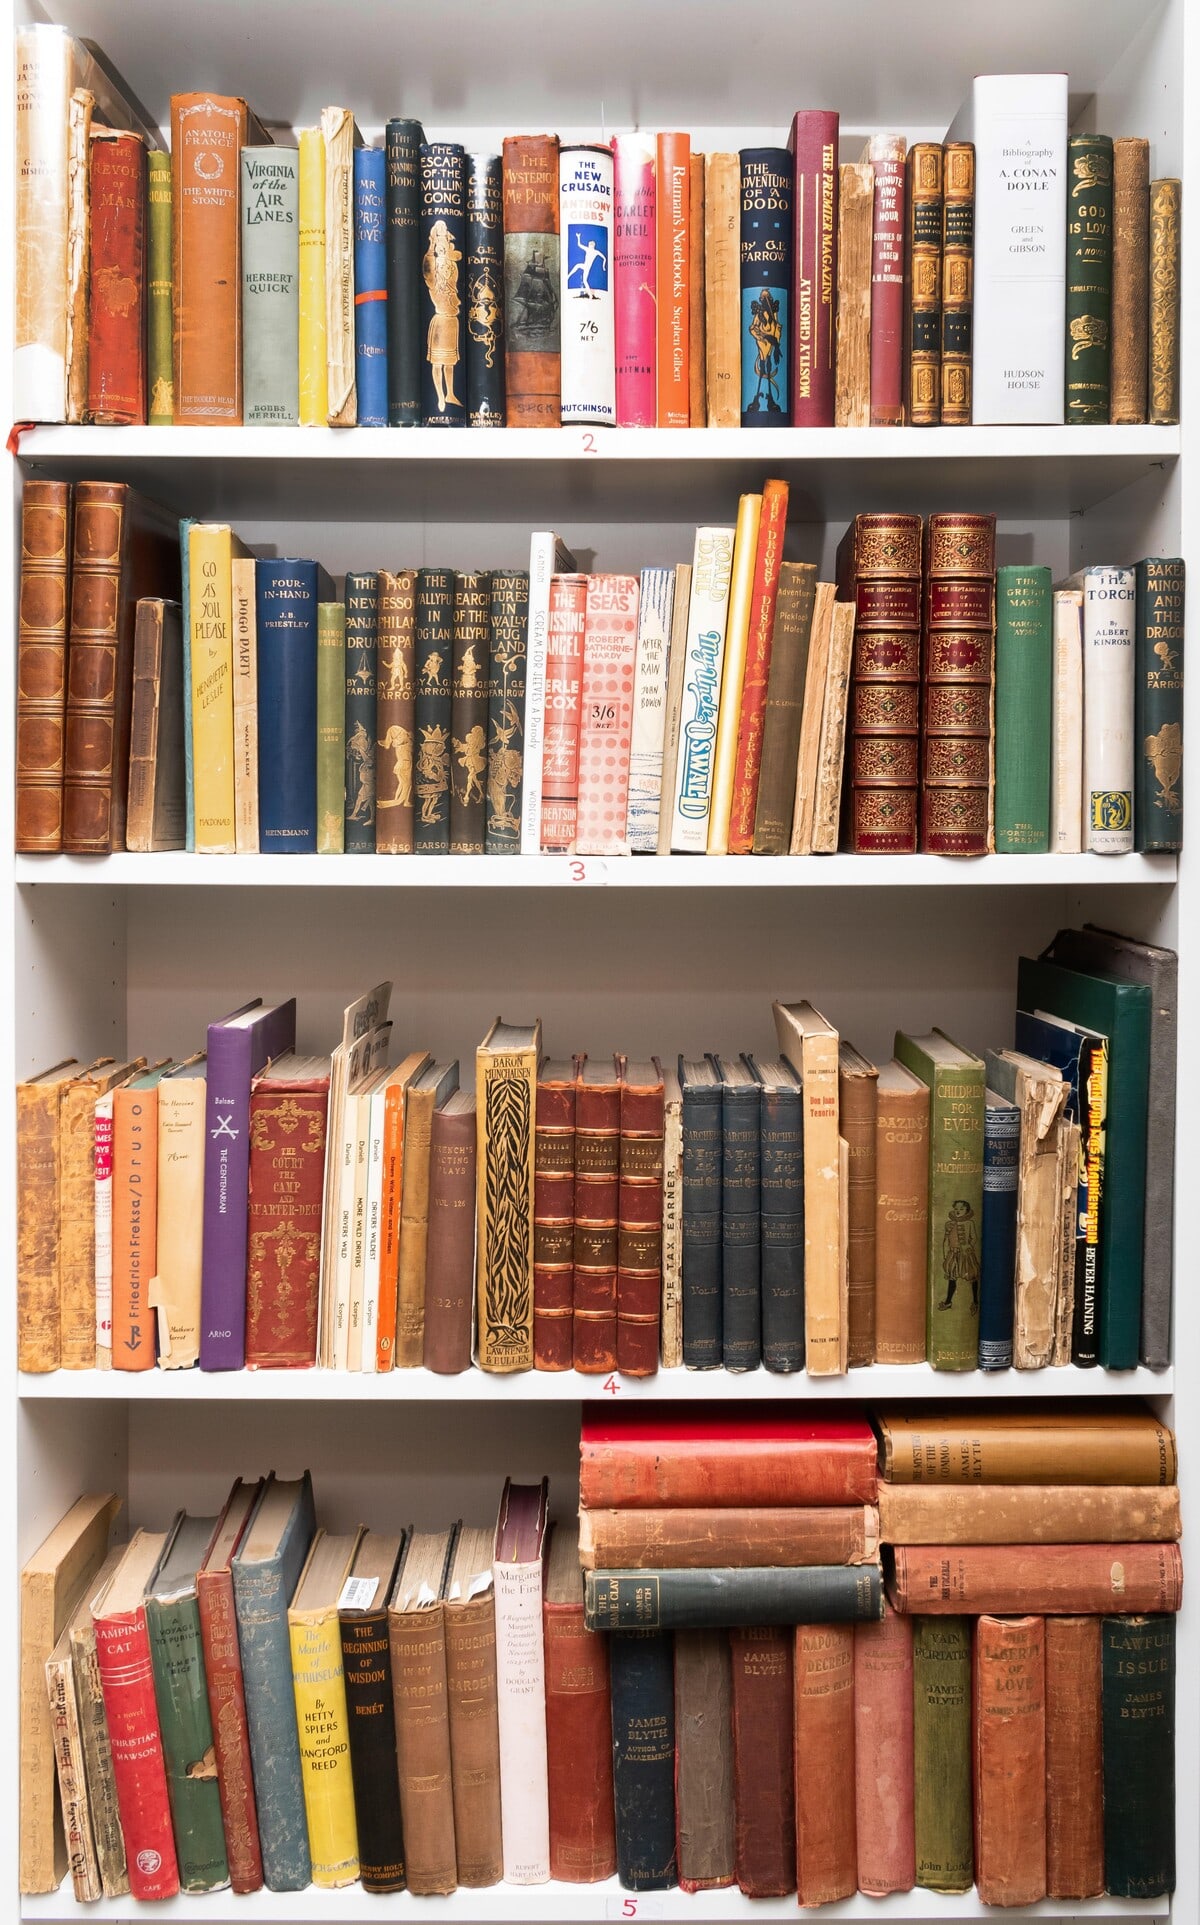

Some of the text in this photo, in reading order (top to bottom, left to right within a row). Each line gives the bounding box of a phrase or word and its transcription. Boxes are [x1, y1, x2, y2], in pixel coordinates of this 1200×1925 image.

[185, 130, 234, 139] ANATOLE
[185, 137, 233, 147] FRANCE
[1002, 148, 1053, 158] Bibliography
[245, 160, 295, 180] VIRGINIA
[746, 164, 769, 174] THE
[999, 168, 1056, 177] A. CONAN
[575, 171, 602, 181] NEW
[252, 179, 288, 191] of the
[562, 182, 610, 195] CRUSADE
[1007, 181, 1049, 191] DOYLE
[205, 188, 235, 198] WHITE
[255, 190, 283, 207] AIR
[424, 192, 460, 205] GONG
[192, 196, 225, 206] STONE
[744, 199, 788, 210] DODO
[246, 207, 293, 225] LANES
[571, 211, 604, 222] GIBBS
[1078, 205, 1106, 218] GOD
[822, 144, 833, 304] THE PREMIER MAGAZINE
[1011, 225, 1043, 233] GREEN
[1009, 244, 1045, 252] GIBSON
[741, 251, 785, 262] FARROW
[246, 274, 293, 283] HERBERT
[672, 166, 686, 382] Ratman's Notebooks Stephen Gilbert
[249, 283, 289, 293] QUICK
[800, 278, 811, 398] MOSTLY GHOSTLY
[1003, 370, 1044, 378] HUDSON
[1008, 381, 1040, 389] HOUSE
[248, 411, 294, 420] MERRILL
[561, 405, 612, 414] HUTCHINSON
[582, 434, 597, 453] 2
[765, 531, 779, 586] DROWSY
[202, 562, 217, 576] GO
[711, 536, 732, 602] ROALD
[272, 579, 305, 588] FOUR-
[204, 584, 216, 598] AS
[265, 589, 310, 599] IN-HAND
[493, 591, 528, 602] TURES
[1088, 589, 1134, 600] TORCH
[590, 594, 628, 611] SEAS
[201, 602, 221, 619] YOU
[502, 604, 515, 615] IN
[428, 611, 440, 622] IN
[491, 616, 527, 628] WALLY
[195, 623, 227, 639] PLEASE
[535, 610, 545, 646] SCREAM
[240, 598, 250, 678] POGO PARTY
[496, 629, 519, 640] PUG
[589, 636, 625, 644] ROBERT
[490, 641, 525, 653] LAND
[642, 639, 662, 651] AFTER
[1094, 638, 1130, 646] KINROSS
[647, 651, 659, 661] THE
[641, 662, 659, 675] RAIN
[196, 662, 228, 697] HENRIETTA
[688, 631, 720, 722] My Uncle
[202, 683, 224, 709] LESLIE
[641, 686, 658, 695] JOHN
[641, 697, 661, 709] BOWEN
[592, 704, 614, 720] 3/6
[679, 722, 716, 819] OSWALD
[199, 818, 231, 826] MACDONALD
[569, 862, 585, 880] 3
[493, 1057, 522, 1067] BARON
[485, 1068, 531, 1078] MUNCHAUSEN
[951, 1102, 973, 1114] FOR
[943, 1116, 980, 1131] EVER
[885, 1131, 922, 1143] GOLD
[1086, 1049, 1103, 1243] THE MAN WHO WAS FRANKENSTEIN
[272, 1157, 304, 1169] COURT
[219, 1164, 227, 1213] CENTENARIAN
[273, 1181, 300, 1193] CAMP
[354, 1198, 364, 1216] MORE
[352, 1220, 362, 1237] WILD
[666, 1282, 674, 1310] THE
[1084, 1247, 1096, 1335] PETER HAINING
[486, 1346, 530, 1354] LAWRENCE
[603, 1376, 620, 1394] 4
[940, 1438, 950, 1478] COMMON
[961, 1440, 969, 1478] JAMES
[972, 1440, 982, 1478] BLYTH
[500, 1569, 542, 1583] Margaret
[501, 1583, 541, 1594] the First
[599, 1593, 608, 1614] THE
[610, 1578, 620, 1628] SAME CLAY
[160, 1624, 194, 1636] VOYAGE
[305, 1630, 320, 1641] The
[354, 1627, 373, 1637] THE
[108, 1641, 131, 1655] CAT
[343, 1639, 388, 1653] BEGINNING
[360, 1658, 372, 1668] OF
[348, 1670, 385, 1682] WISDOM
[927, 1685, 964, 1694] JAMES
[928, 1695, 964, 1706] BLYTH
[1125, 1691, 1162, 1702] JAMES
[316, 1698, 325, 1709] By
[356, 1703, 384, 1715] BENÉT
[305, 1710, 334, 1721] HETTY
[1121, 1705, 1165, 1717] BLYTH
[305, 1722, 338, 1733] SPIERS
[628, 1717, 667, 1727] JAMES
[111, 1732, 158, 1748] CHRISTIAN
[316, 1735, 331, 1744] and
[628, 1728, 667, 1740] BLYTH
[116, 1746, 157, 1761] MAWSON
[311, 1759, 337, 1770] REED
[622, 1900, 637, 1916] 5
